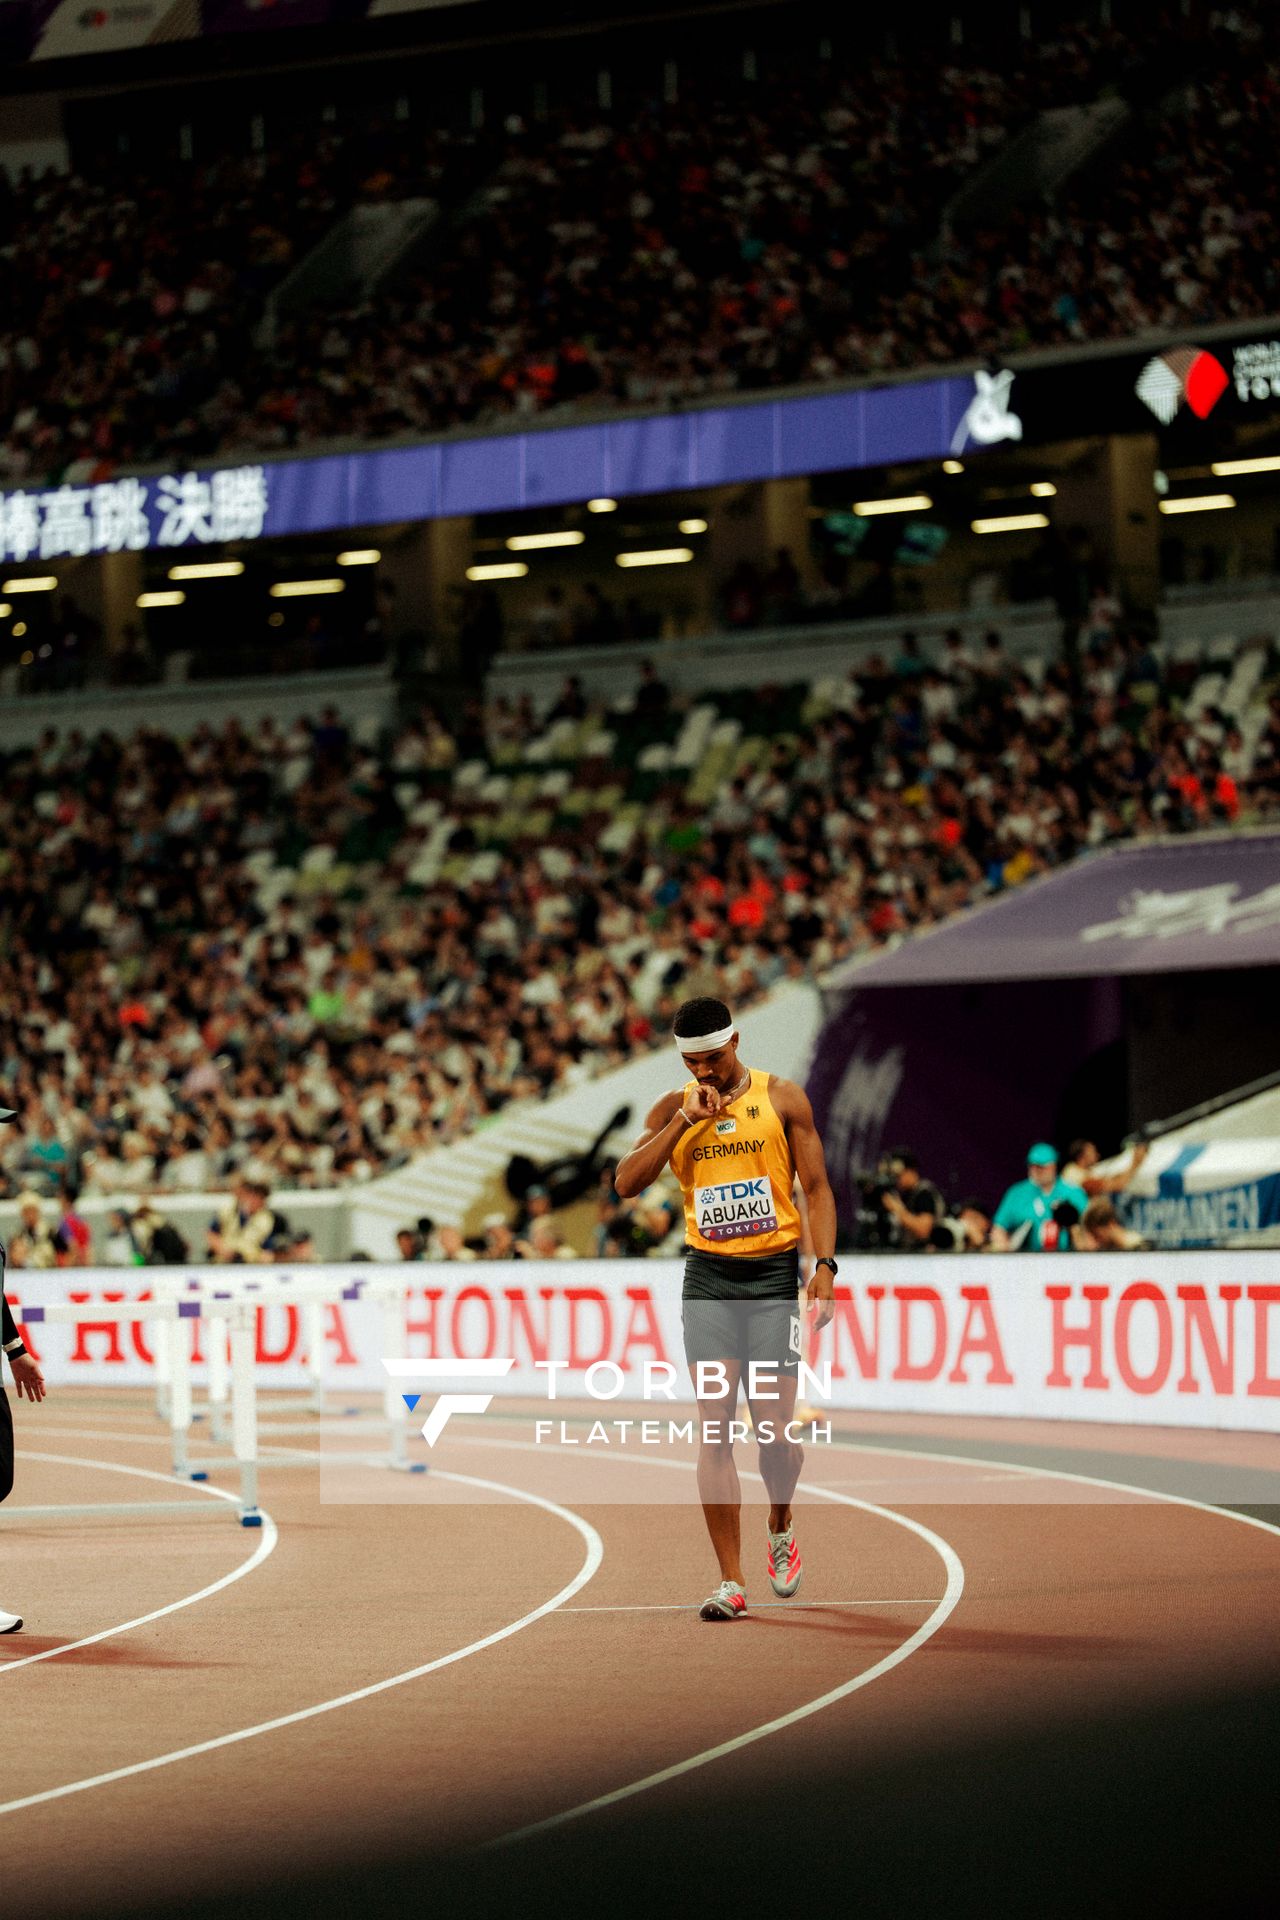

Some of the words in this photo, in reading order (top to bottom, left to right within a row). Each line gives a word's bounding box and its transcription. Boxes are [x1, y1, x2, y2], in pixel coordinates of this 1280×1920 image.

[692, 1139, 766, 1162] GERMANY
[714, 1179, 766, 1202] TDK
[701, 1198, 771, 1226] ABUAKU
[405, 1284, 679, 1374] HONDA
[793, 1323, 800, 1349] 8
